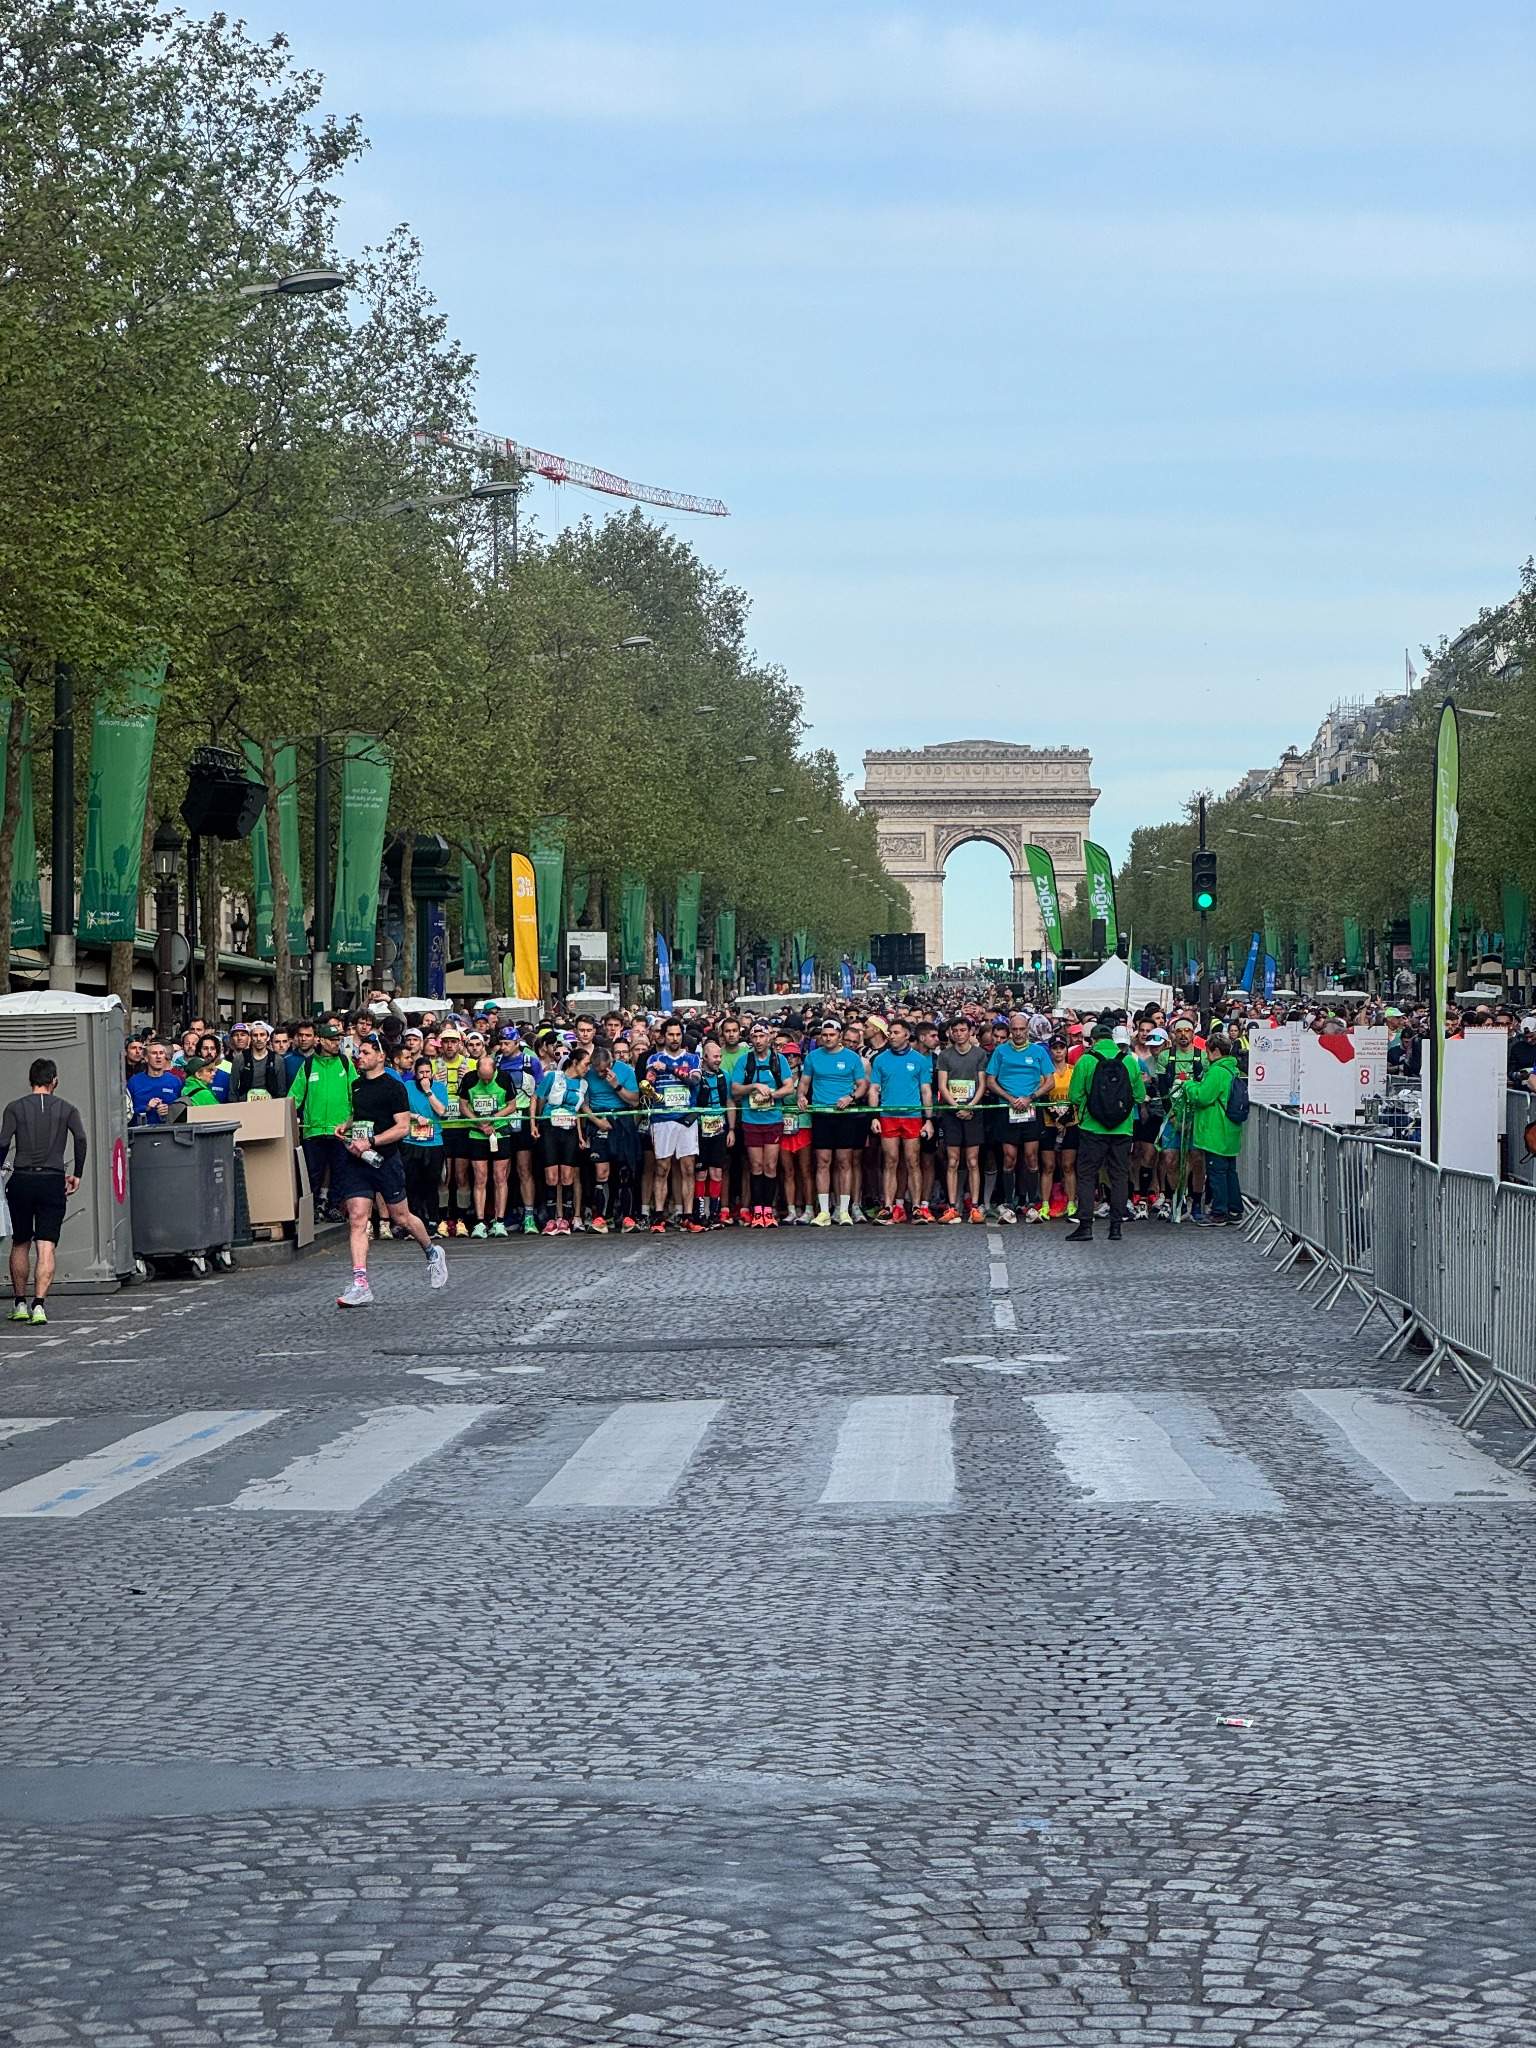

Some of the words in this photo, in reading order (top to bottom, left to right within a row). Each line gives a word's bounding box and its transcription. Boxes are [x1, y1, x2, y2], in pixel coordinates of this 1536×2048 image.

[1036, 875, 1056, 928] SHOKZ
[1255, 1065, 1266, 1082] 9
[1360, 1069, 1370, 1085] 8
[1299, 1103, 1331, 1115] HALL
